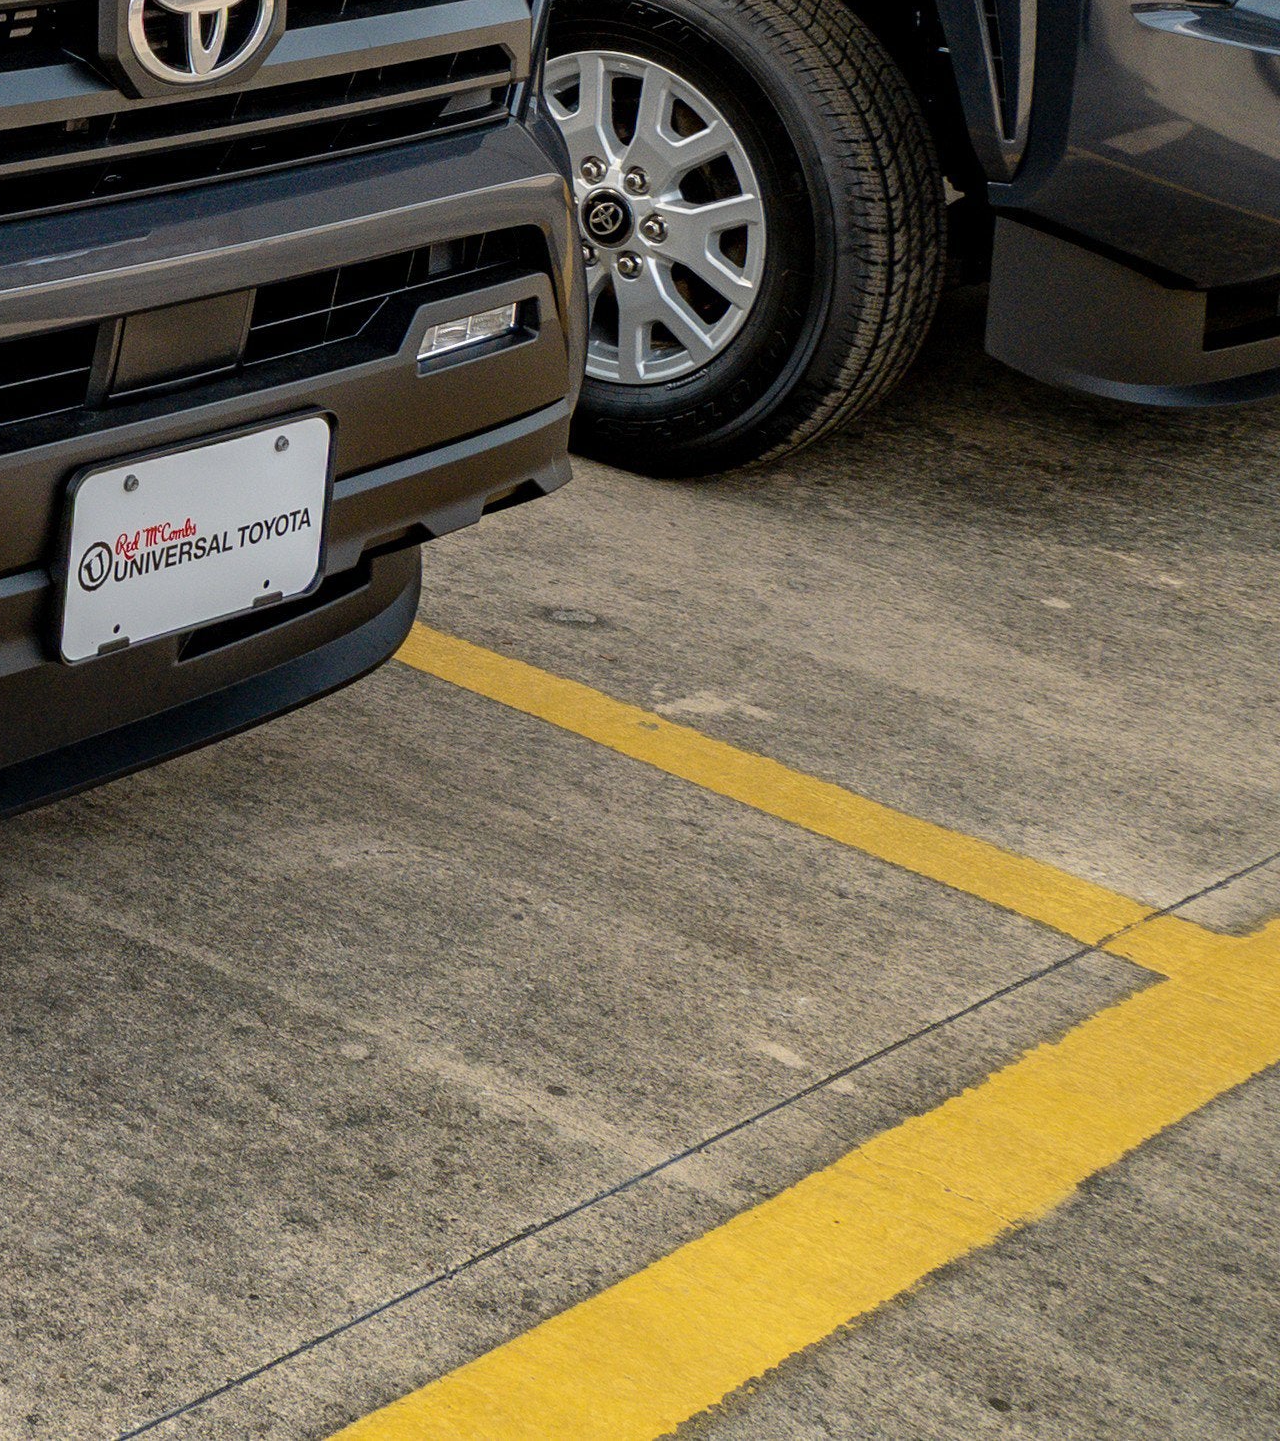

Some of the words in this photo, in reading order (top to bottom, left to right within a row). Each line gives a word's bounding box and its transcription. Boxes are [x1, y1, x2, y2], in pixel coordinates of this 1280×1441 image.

[114, 531, 233, 583] UNIVERSAL
[237, 507, 313, 548] TOYOTA
[115, 530, 141, 560] Red
[143, 517, 197, 548] McCombs
